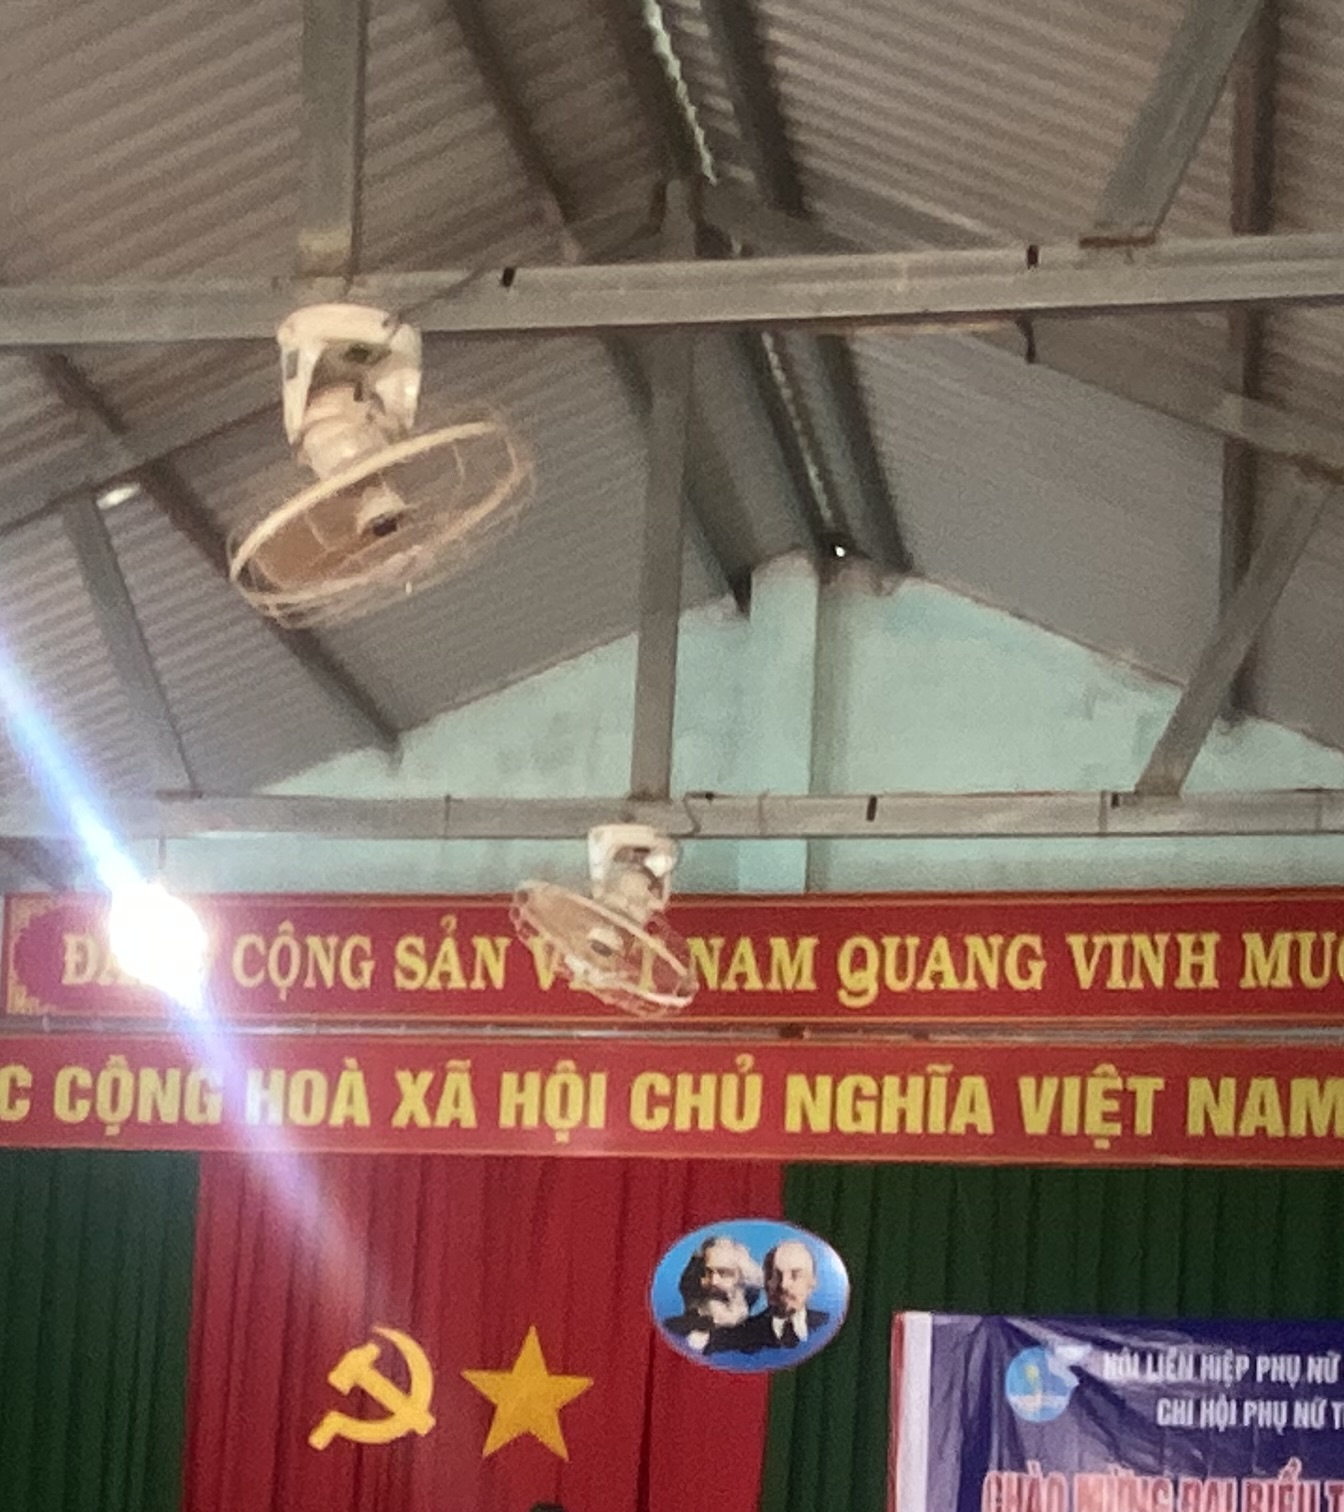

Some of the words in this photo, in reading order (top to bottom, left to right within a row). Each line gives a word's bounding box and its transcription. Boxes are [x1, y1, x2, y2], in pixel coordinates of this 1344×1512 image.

[231, 919, 375, 1002] CỘNG
[393, 914, 511, 991] SẢN
[687, 936, 819, 991] NAM
[1065, 932, 1221, 990] VINH
[53, 1054, 223, 1137] CỘNG
[245, 1057, 372, 1127] HOÀ
[391, 1059, 478, 1129] XÃ
[499, 1060, 607, 1144] HỘI
[628, 1053, 763, 1133] CHỦ
[784, 1063, 995, 1135] NGHĨA
[1018, 1063, 1164, 1150] VIỆT
[1199, 1347, 1250, 1388] HIỆP
[1256, 1353, 1301, 1389] PHỤ
[1307, 1350, 1341, 1385] NỮ
[1157, 1398, 1194, 1428] CHI
[1199, 1393, 1238, 1433] HỘI
[1243, 1399, 1288, 1435] PHỤ
[1293, 1395, 1328, 1429] NỮ
